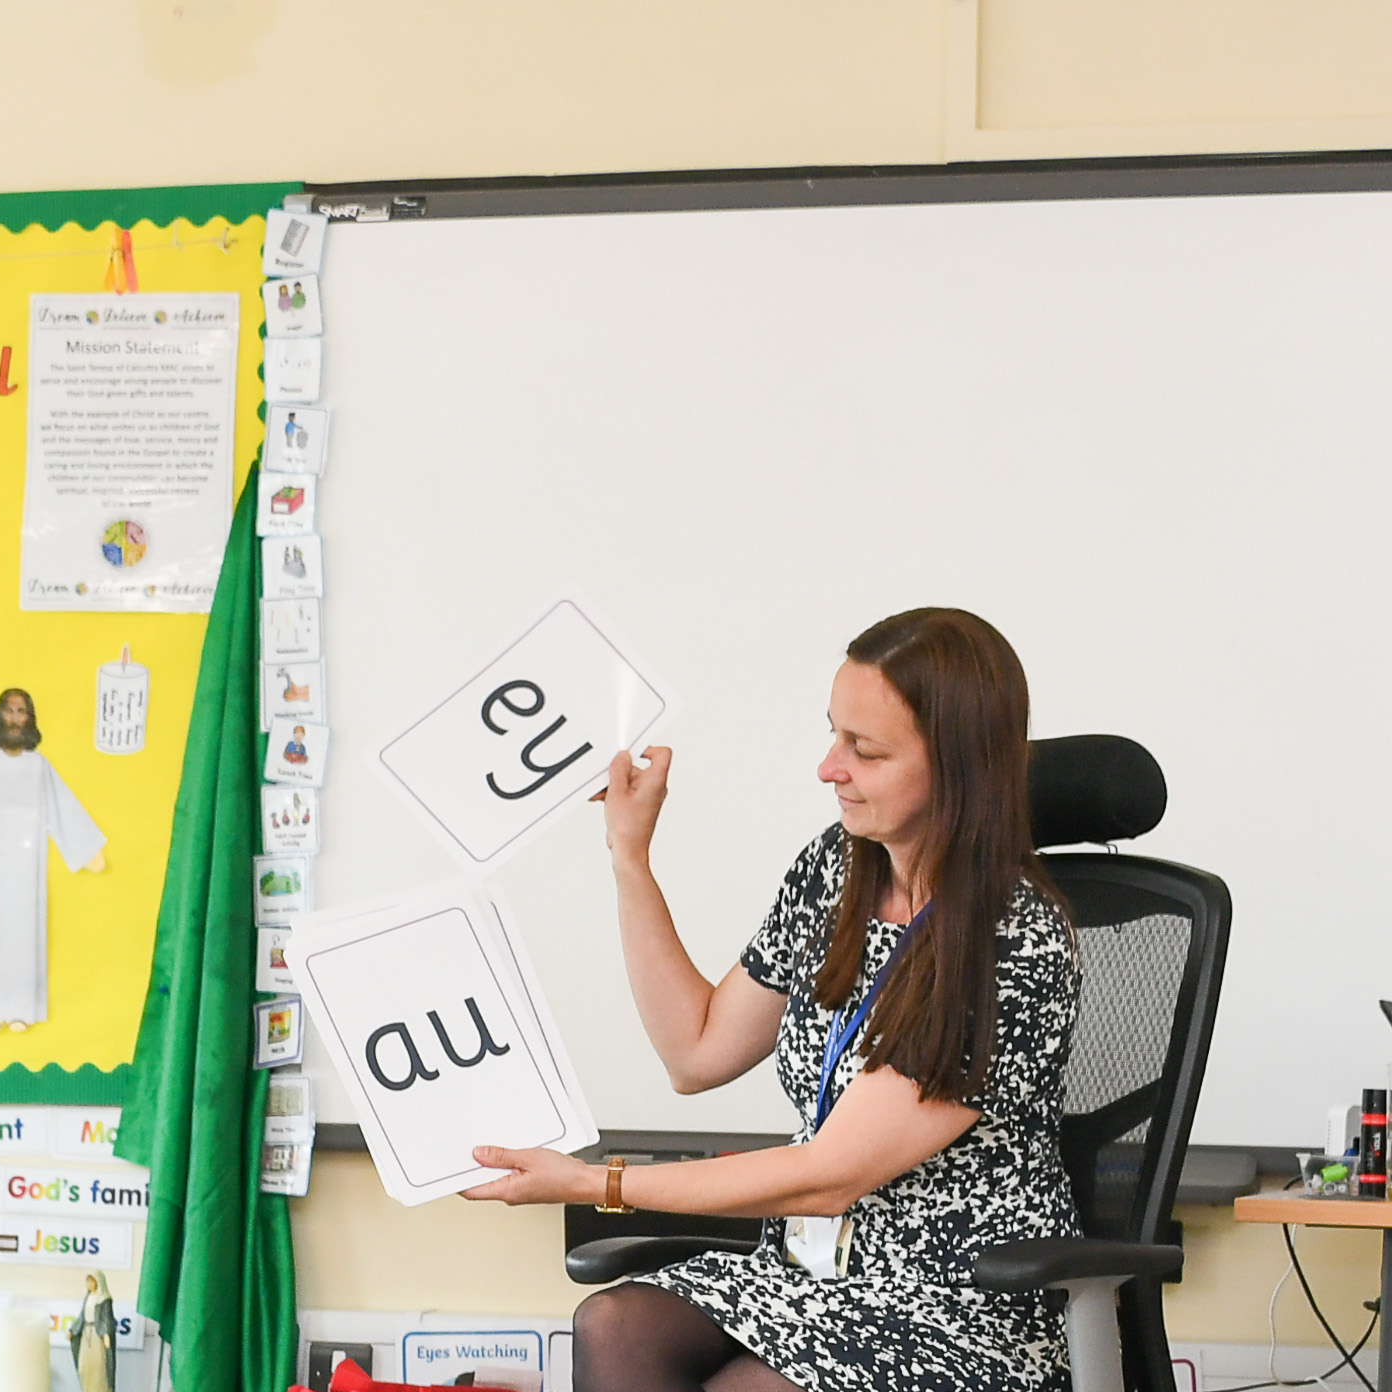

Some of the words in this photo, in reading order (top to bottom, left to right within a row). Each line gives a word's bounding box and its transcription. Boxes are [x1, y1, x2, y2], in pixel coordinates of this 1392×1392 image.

[66, 341, 120, 355] Mission
[480, 679, 594, 802] ey
[365, 996, 511, 1092] au
[8, 1175, 80, 1202] God's
[29, 1229, 101, 1255] Jesus
[416, 1345, 451, 1363] Eyes
[455, 1344, 529, 1362] Watching
